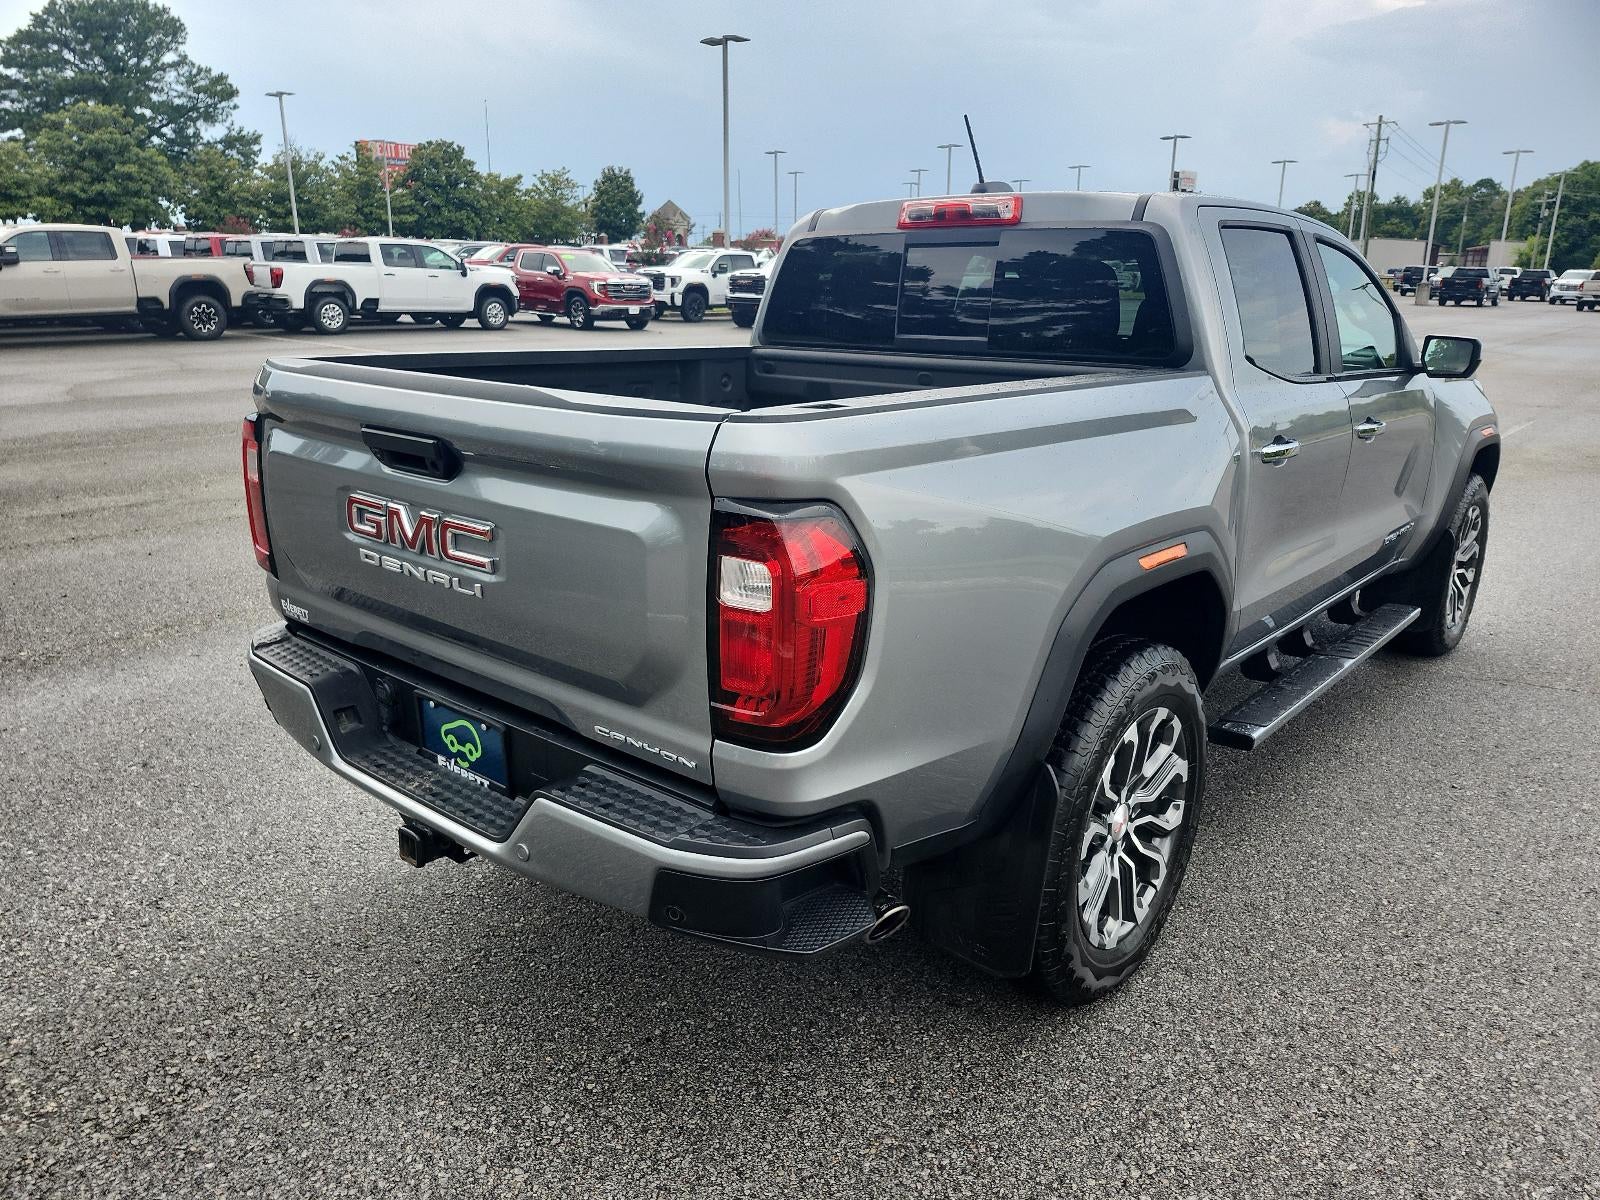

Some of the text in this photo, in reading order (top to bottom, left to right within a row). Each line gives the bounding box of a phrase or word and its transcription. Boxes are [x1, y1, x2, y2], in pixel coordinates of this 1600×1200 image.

[346, 490, 496, 574] GMC
[359, 547, 484, 599] DENALI
[594, 725, 697, 769] CANYON
